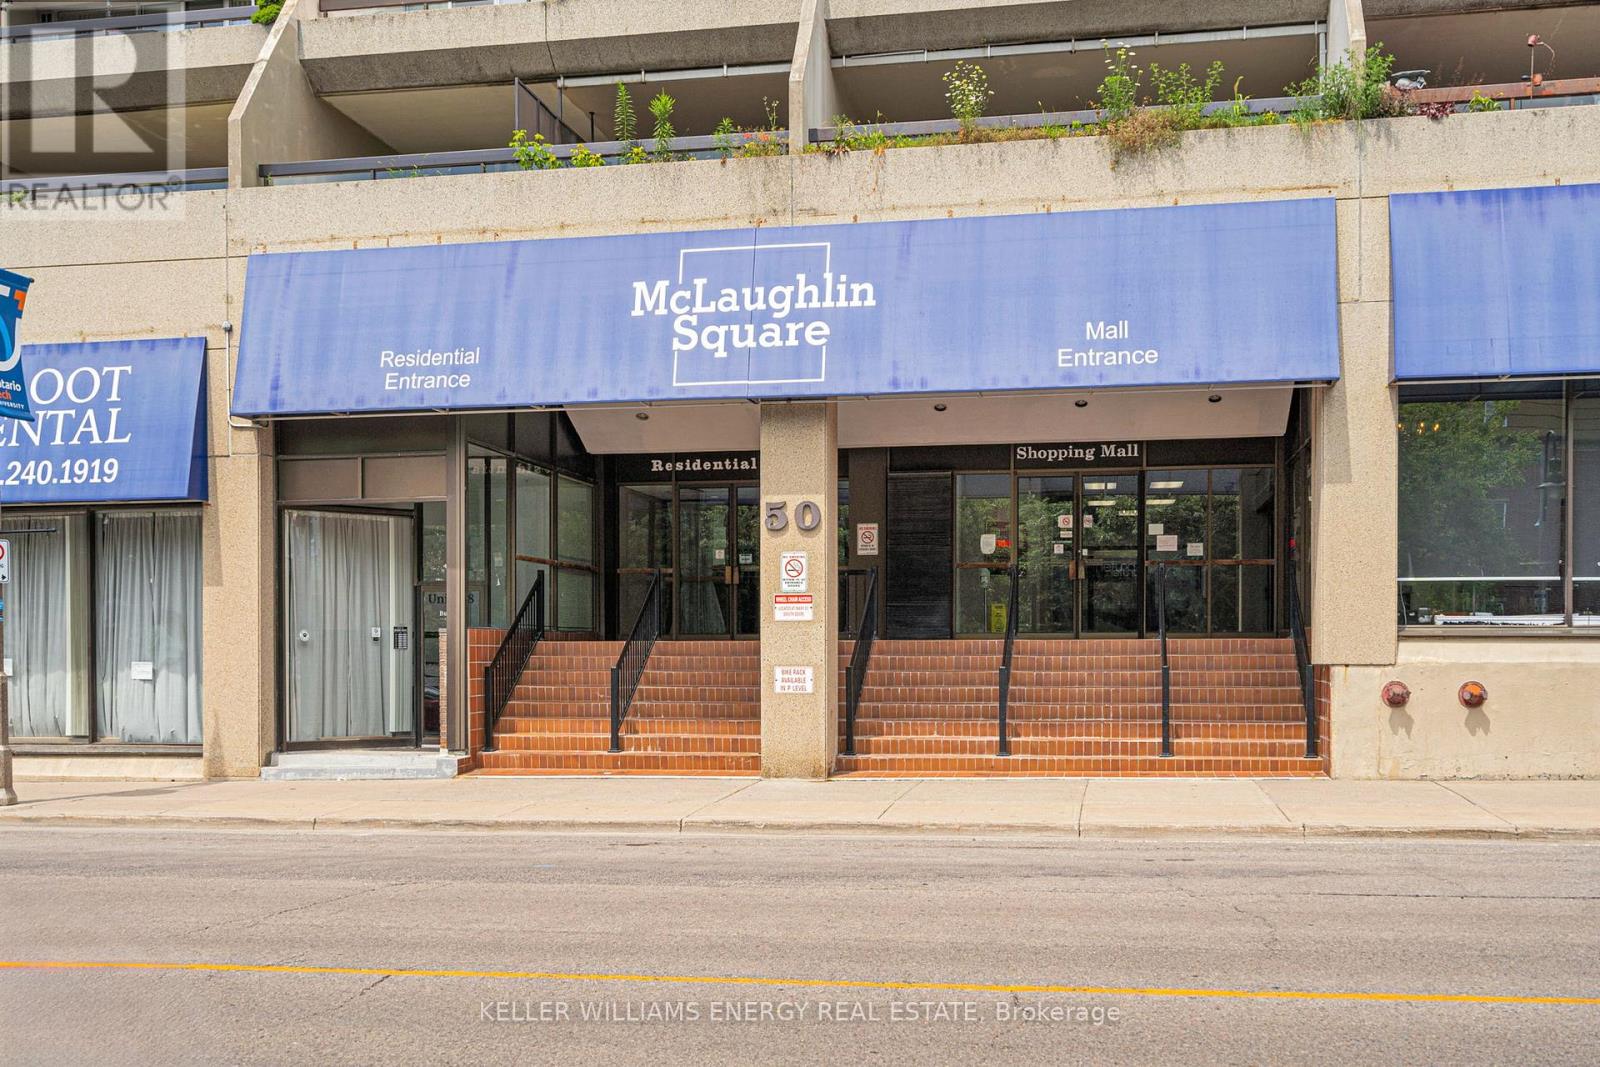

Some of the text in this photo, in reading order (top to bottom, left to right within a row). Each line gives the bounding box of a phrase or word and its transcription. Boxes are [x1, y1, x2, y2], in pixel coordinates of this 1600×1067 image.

[631, 273, 877, 318] McLaughlin
[671, 313, 831, 358] Square
[1085, 319, 1129, 340] Mall
[379, 346, 480, 370] Residential
[1057, 348, 1159, 368] Entrance
[384, 371, 472, 391] Entrance
[1016, 443, 1139, 462] Shopping Mall
[651, 457, 758, 472] Residential
